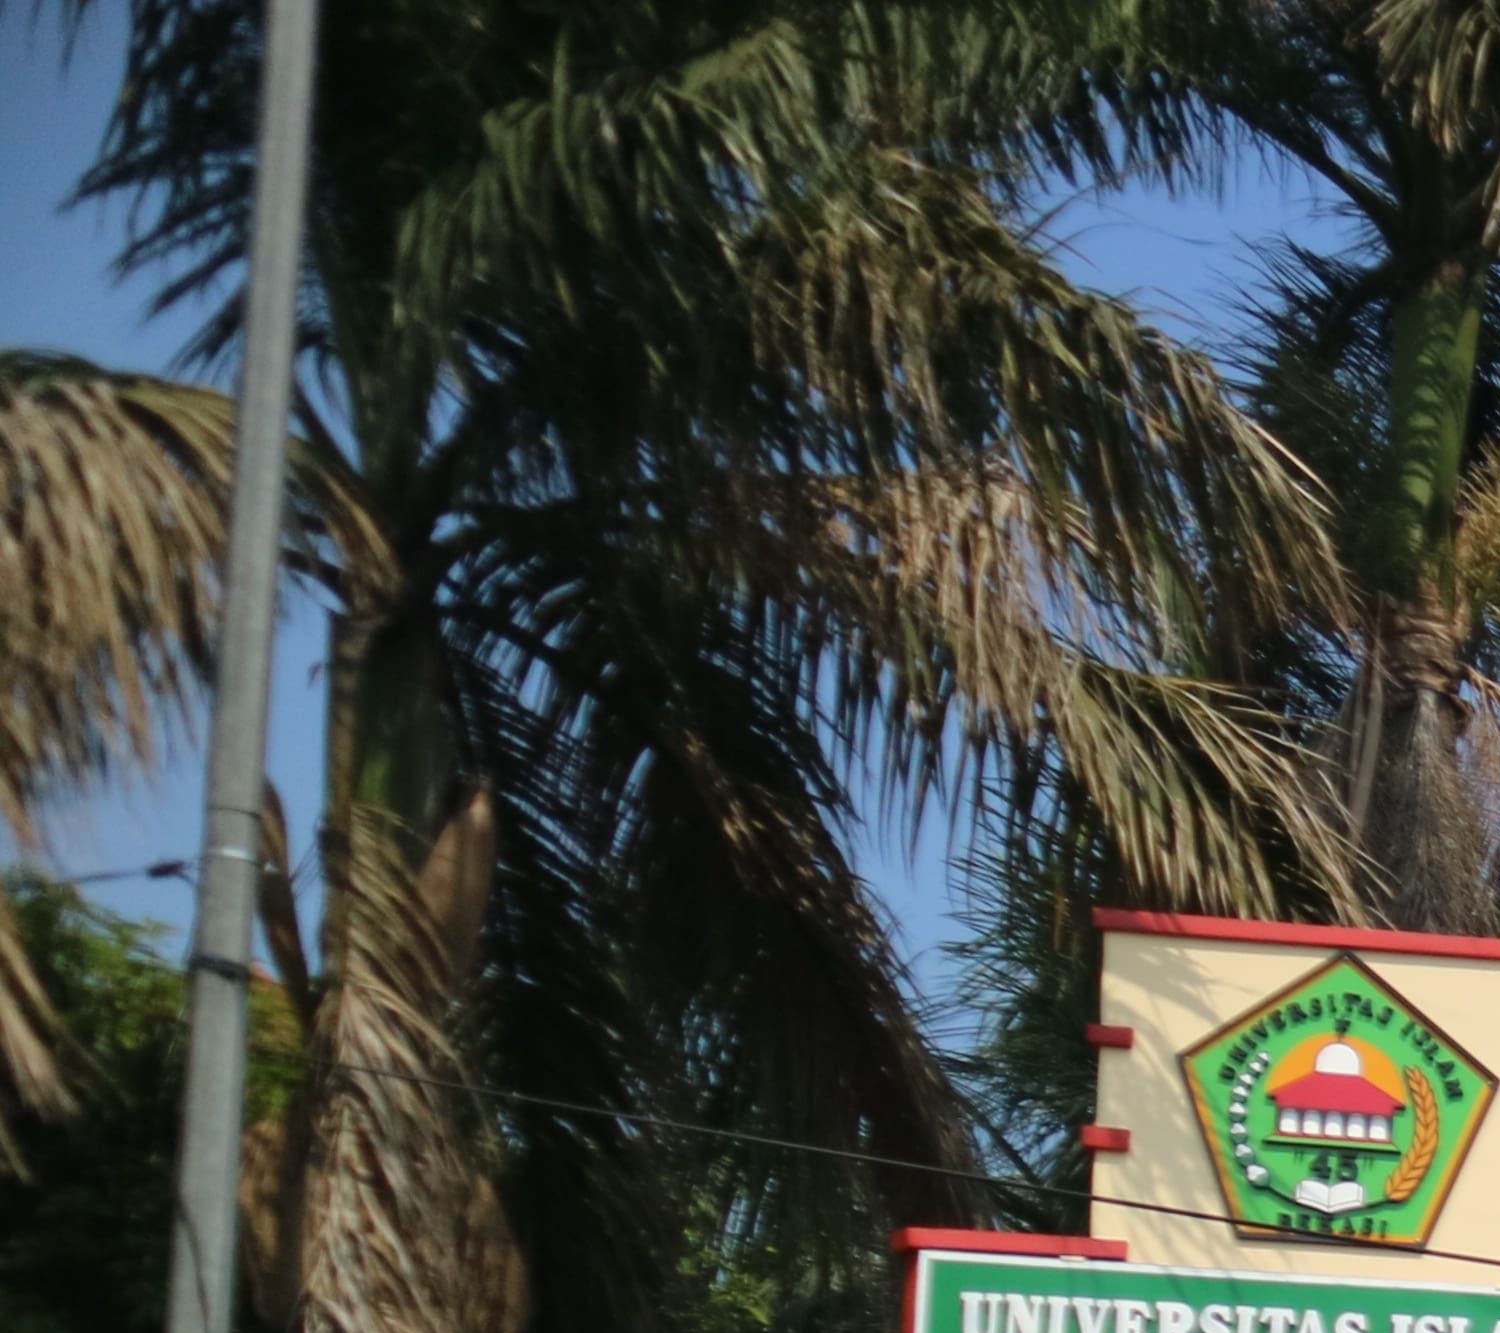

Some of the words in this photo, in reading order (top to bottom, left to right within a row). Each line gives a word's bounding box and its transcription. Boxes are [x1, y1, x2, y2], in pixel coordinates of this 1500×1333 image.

[1218, 993, 1394, 1085] UNIVERSITAS
[1401, 1022, 1464, 1101] ISLAM
[1278, 1213, 1388, 1237] BEKASI
